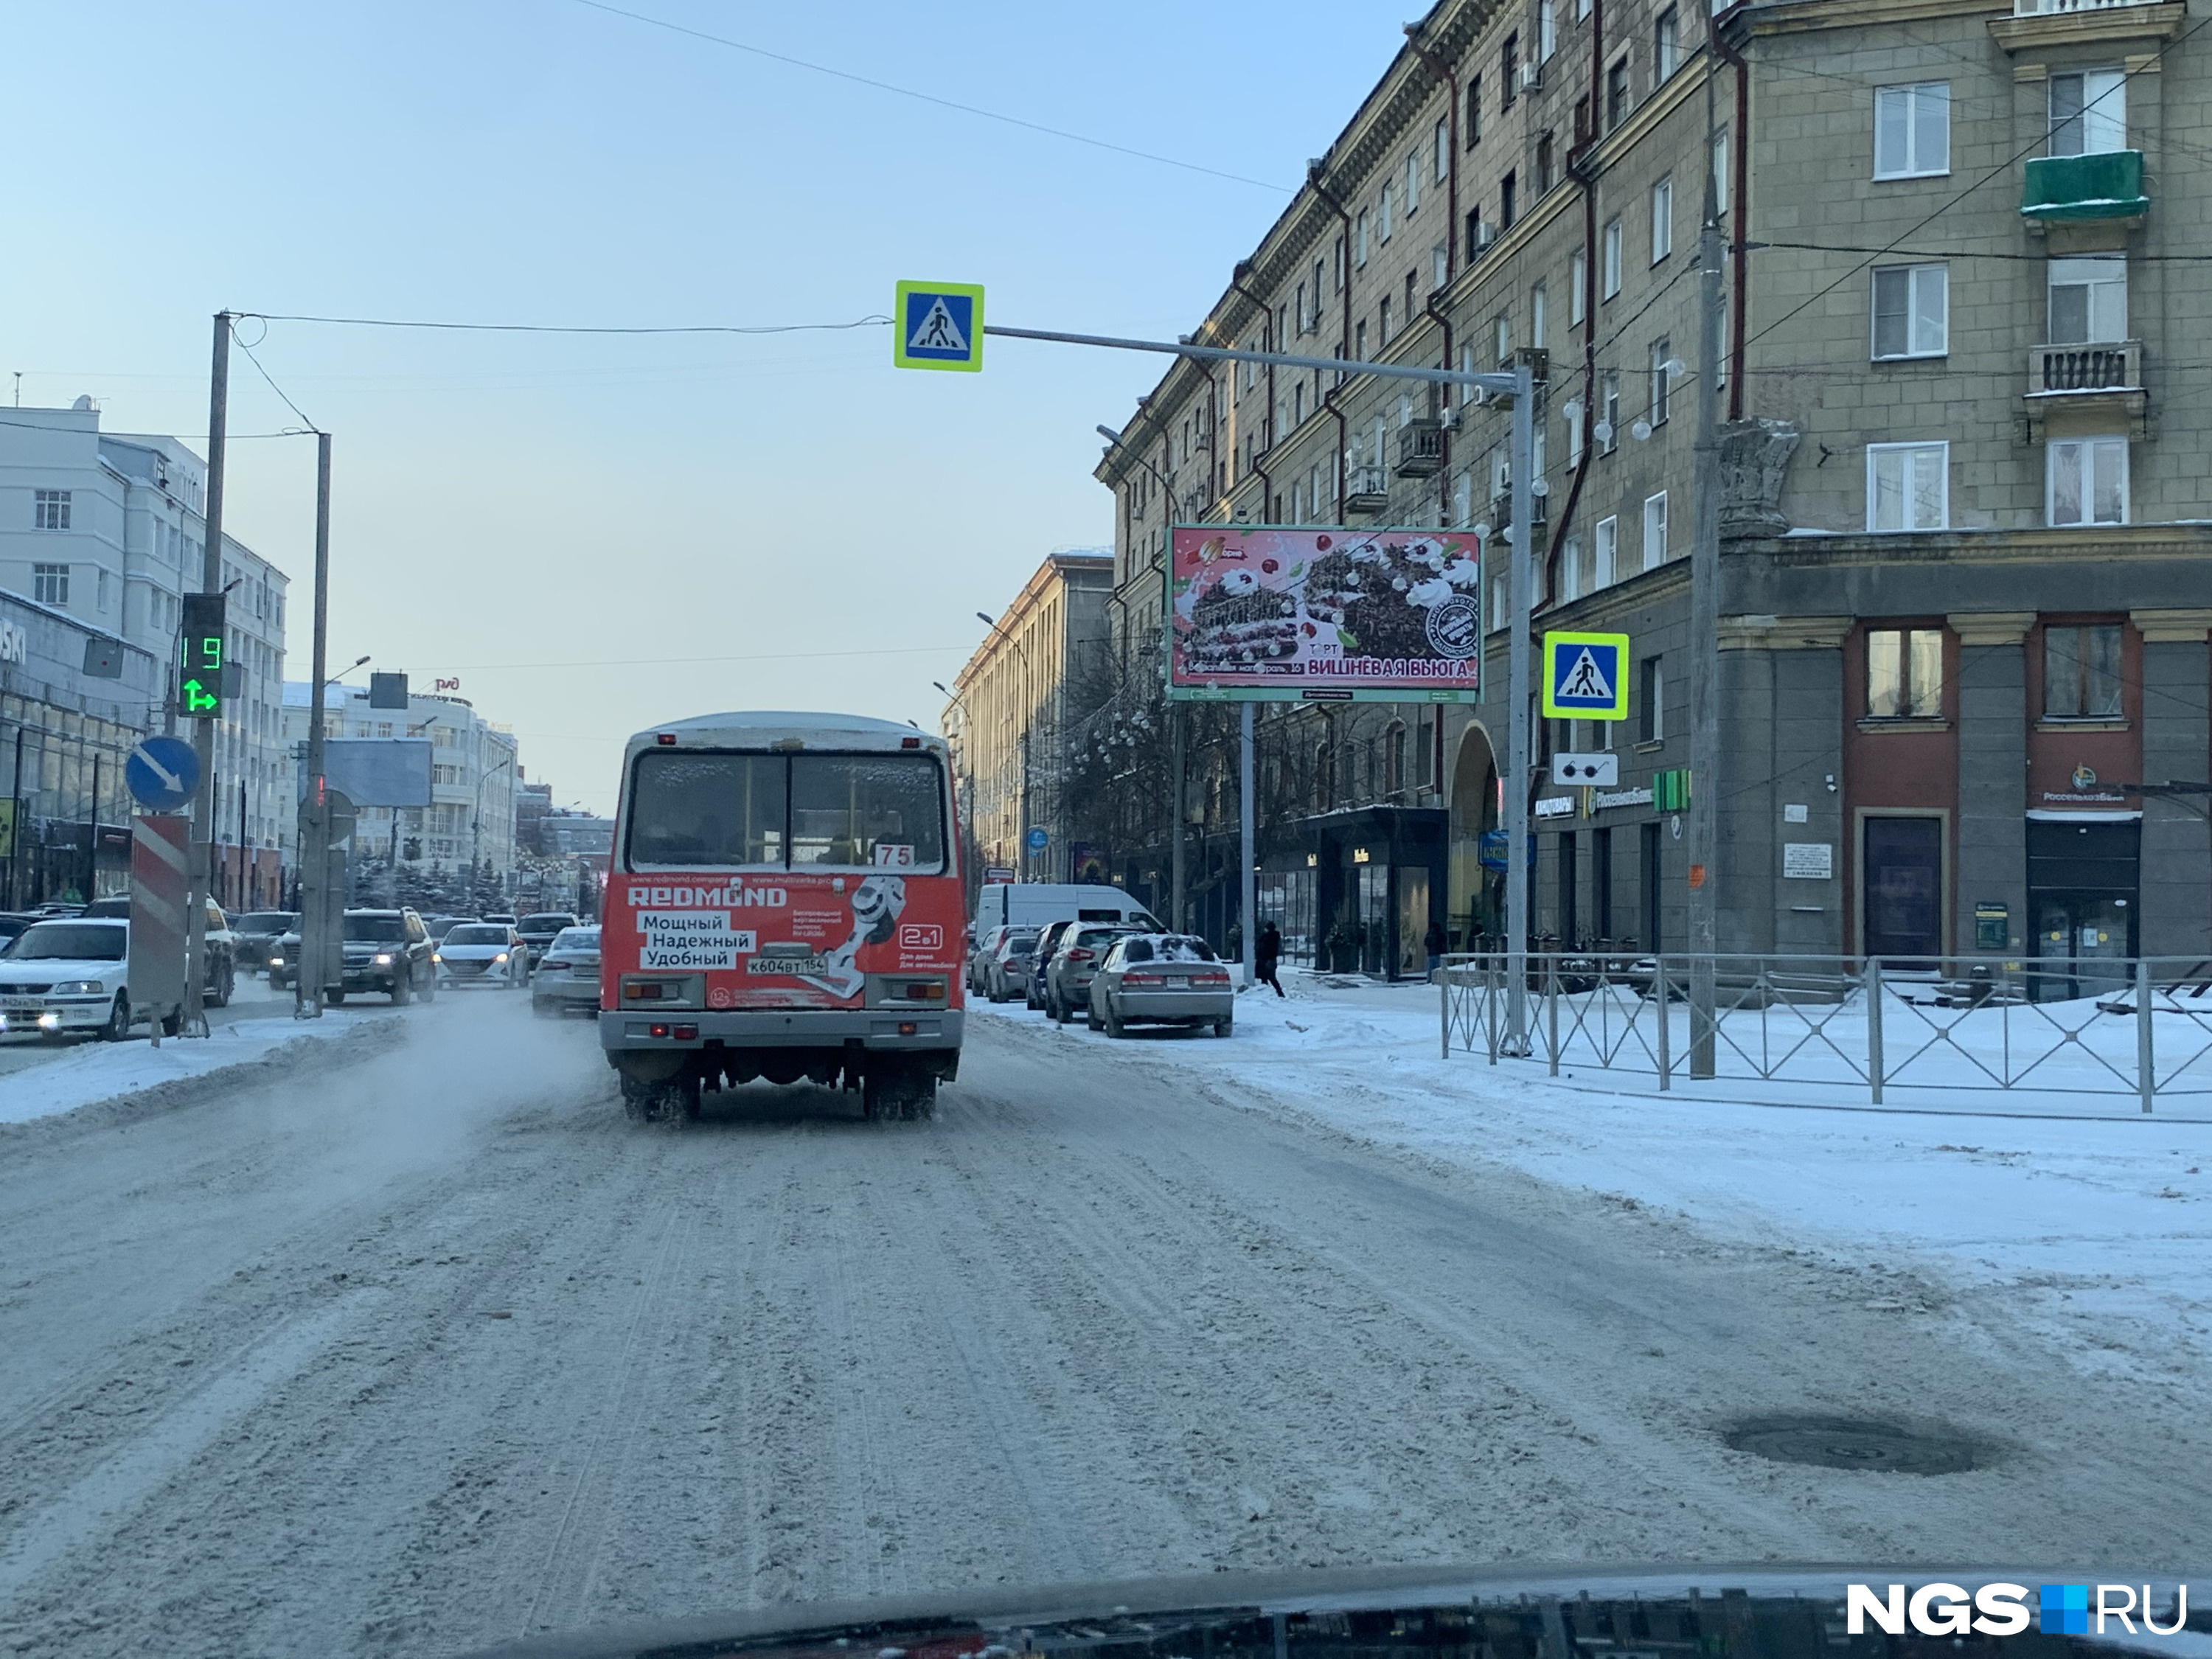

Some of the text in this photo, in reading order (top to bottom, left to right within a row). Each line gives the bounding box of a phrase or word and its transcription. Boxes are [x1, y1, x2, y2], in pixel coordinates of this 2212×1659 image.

[0, 618, 26, 665] SKI
[1310, 644, 1338, 654] ТРТ
[184, 637, 220, 669] 19
[1309, 657, 1467, 677] ВИШНЁВАЯ ВЬЮГА
[881, 846, 910, 866] 75
[628, 887, 787, 906] REDMOND
[644, 916, 723, 931] Мощный
[653, 933, 749, 949] Надежный
[647, 950, 728, 967] Удобный
